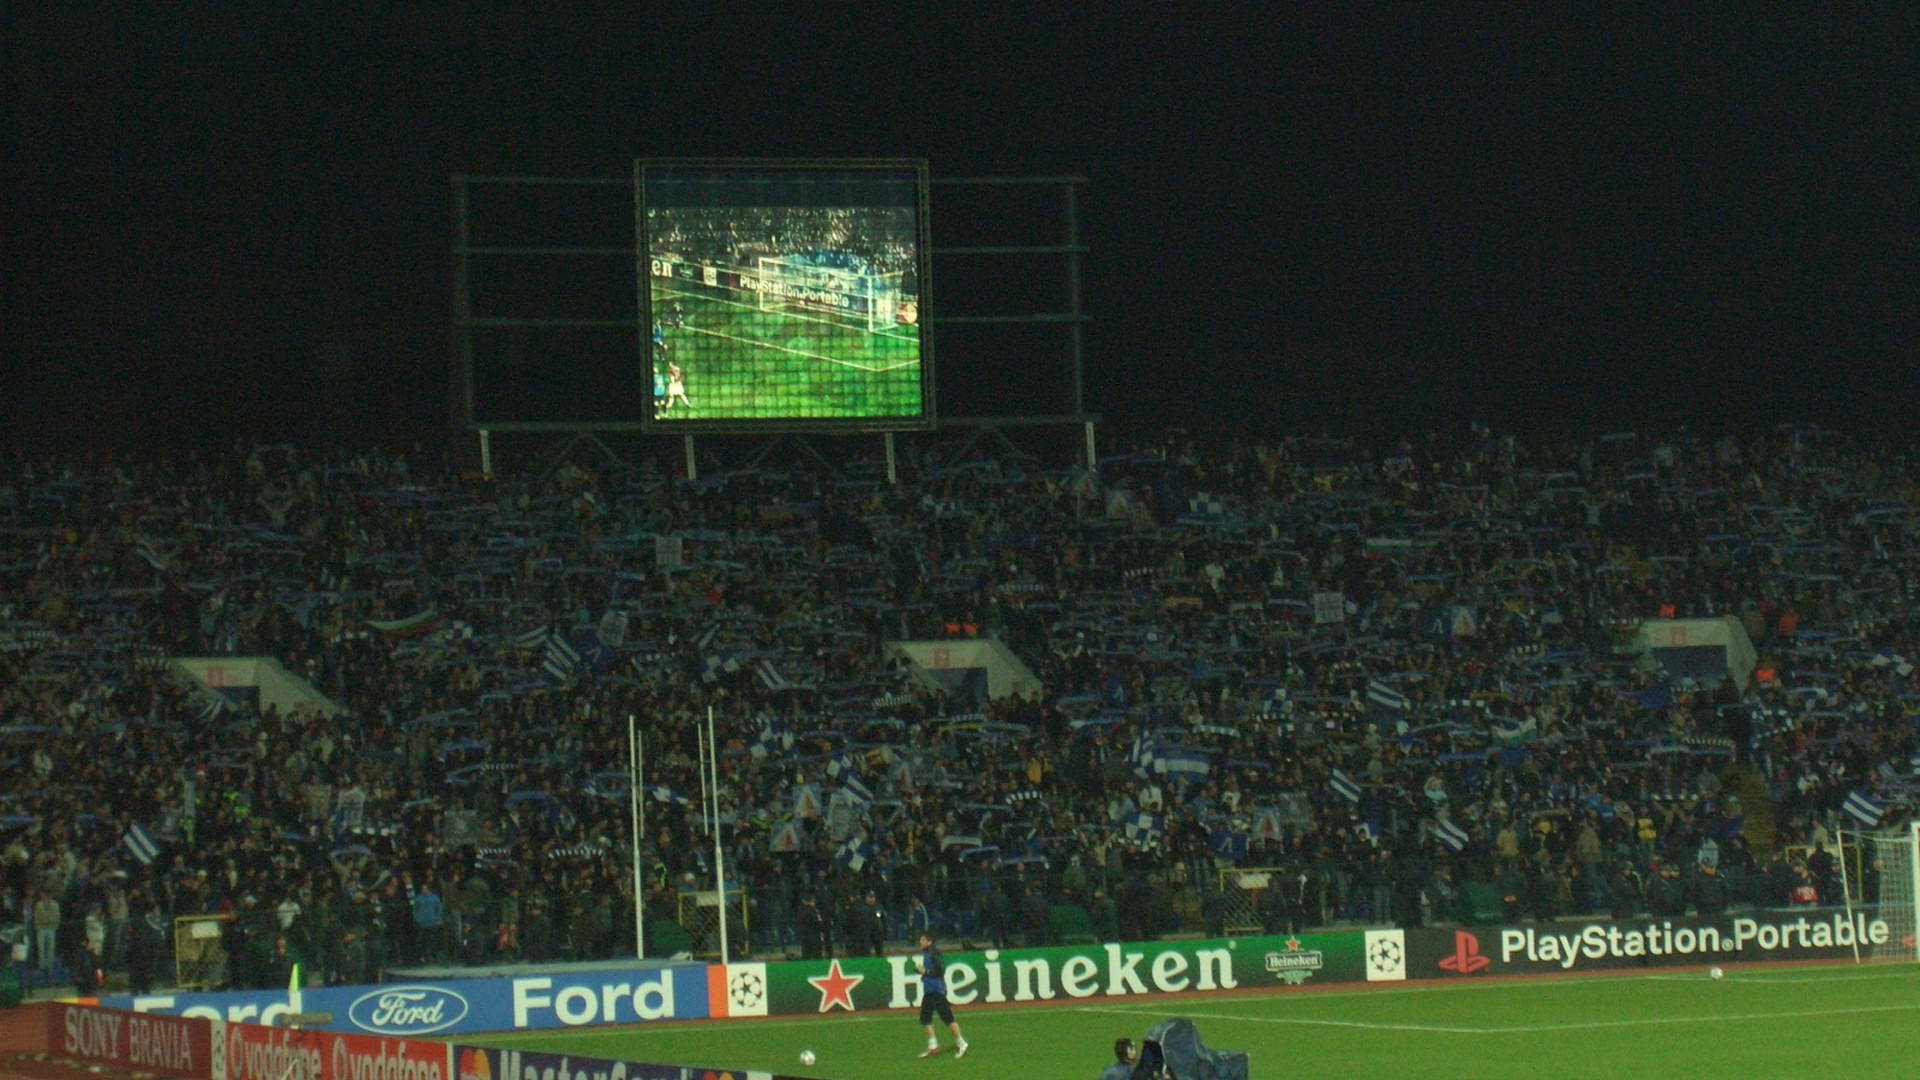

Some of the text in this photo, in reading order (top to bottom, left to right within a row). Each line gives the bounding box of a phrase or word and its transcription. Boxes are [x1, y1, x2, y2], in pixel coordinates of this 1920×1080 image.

[1735, 913, 1889, 951] Portable
[887, 943, 1238, 1008] Heineken
[1269, 955, 1318, 967] Heineken
[372, 992, 444, 1026] Ford
[513, 970, 675, 1027] Ford
[65, 1006, 192, 1071] SONY BRAVIA
